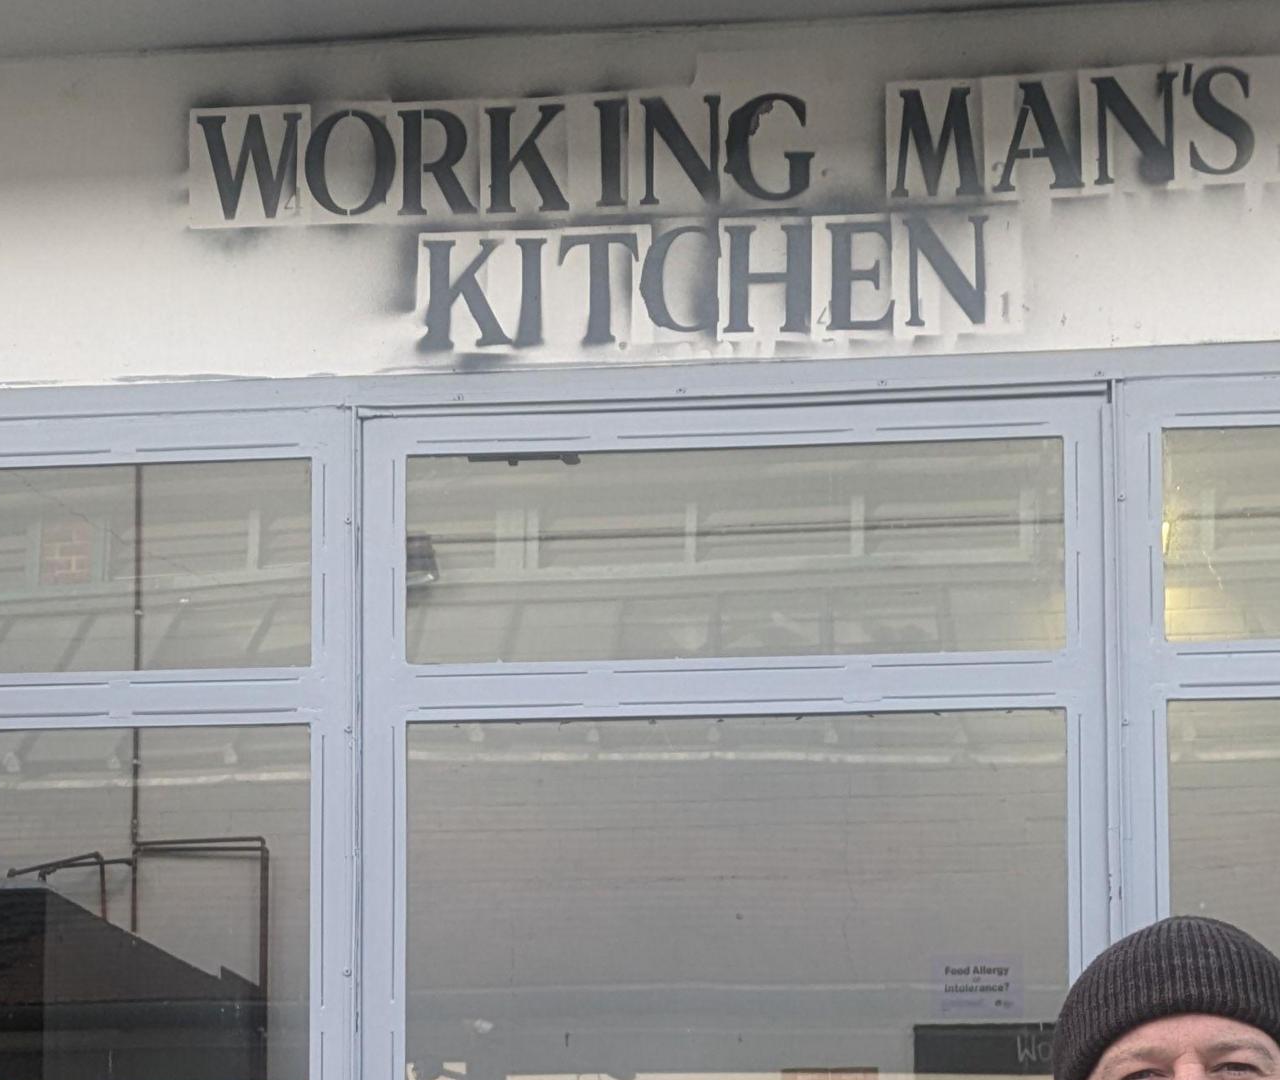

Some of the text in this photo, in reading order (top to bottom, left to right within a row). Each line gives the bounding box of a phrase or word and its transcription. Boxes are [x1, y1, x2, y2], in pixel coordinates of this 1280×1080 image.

[197, 62, 1255, 220] WORKING MAN'S
[417, 216, 989, 351] KITCHEN
[944, 965, 1010, 977] Food Allergy
